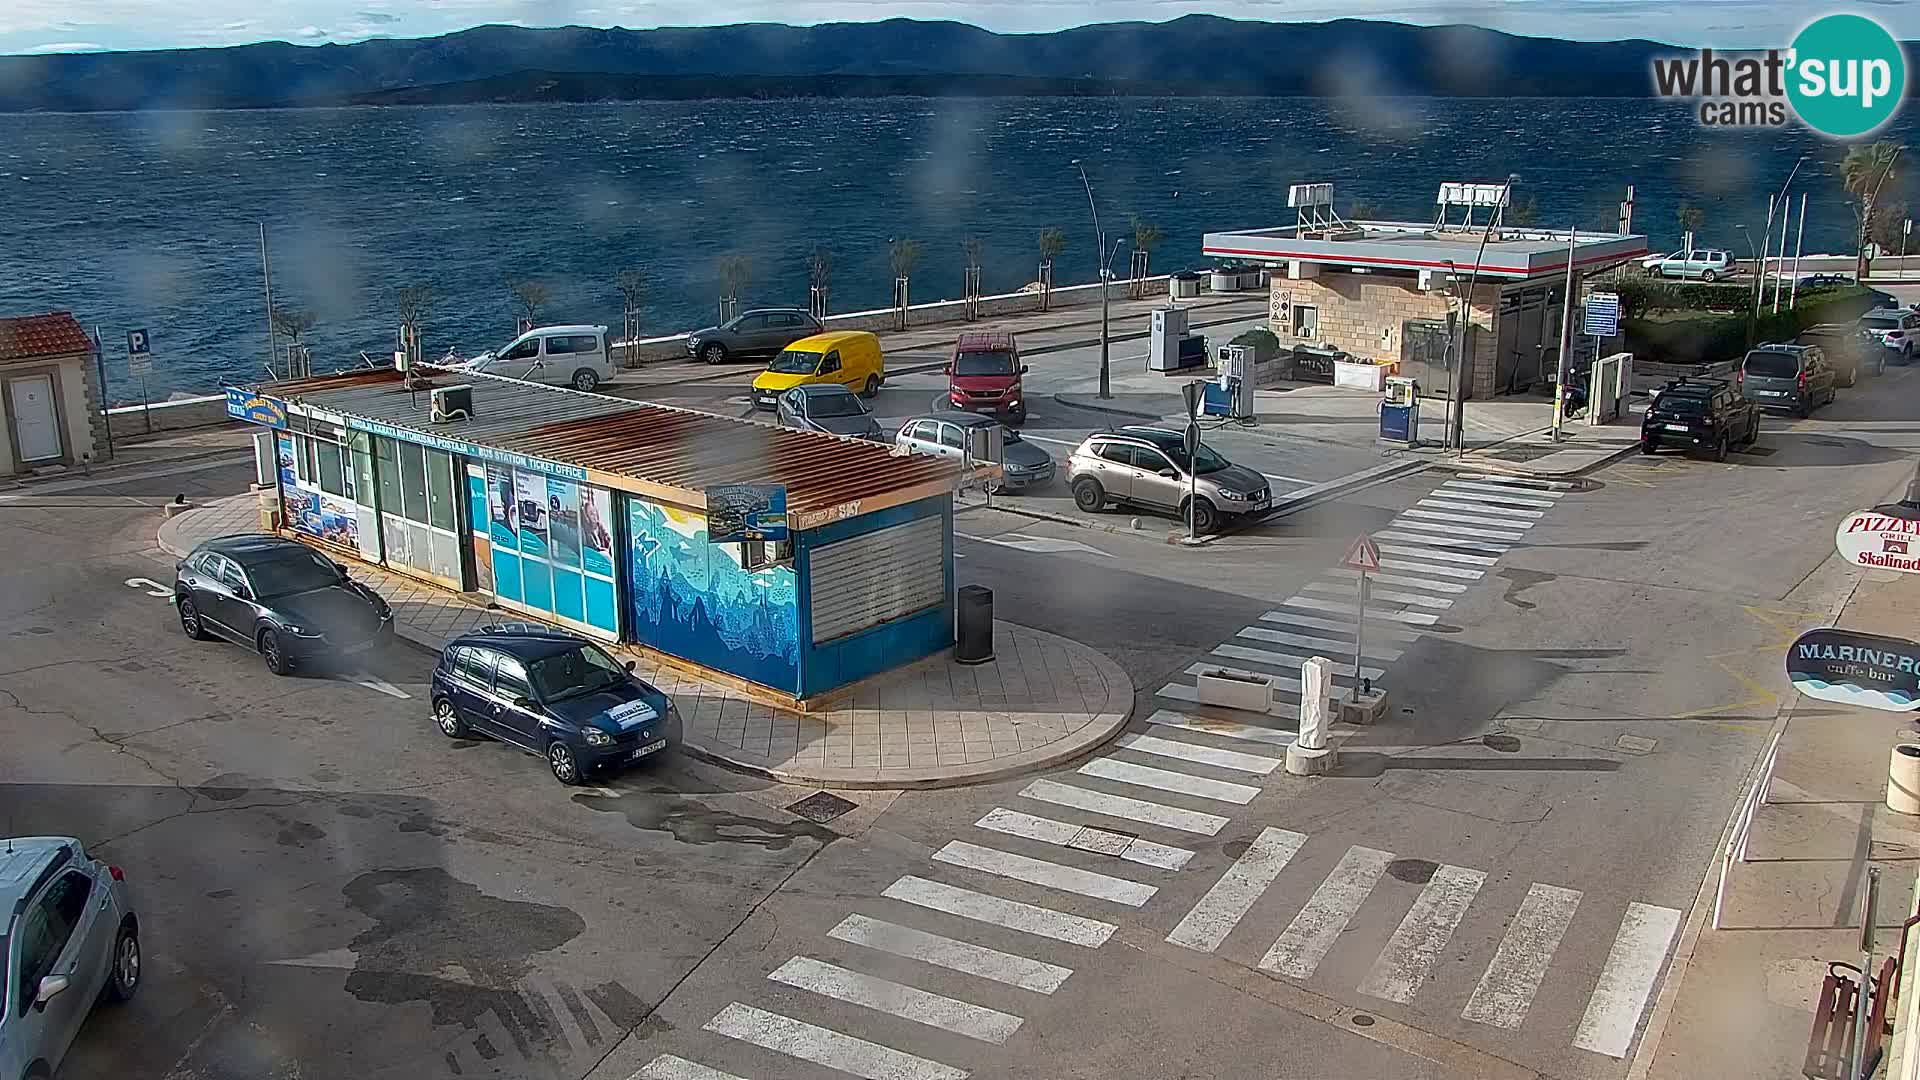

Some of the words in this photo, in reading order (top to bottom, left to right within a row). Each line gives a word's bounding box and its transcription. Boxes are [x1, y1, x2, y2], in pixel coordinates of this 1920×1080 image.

[131, 332, 144, 351] P
[396, 429, 437, 446] AUTOBUSNA
[437, 438, 468, 454] POSTAJA
[479, 447, 494, 458] BUS
[494, 450, 527, 467] STATION
[528, 459, 554, 473] TICKET
[555, 465, 583, 478] OFFICE
[838, 500, 862, 518] SKY
[1880, 532, 1915, 542] GRILL
[1827, 664, 1865, 677] caffe
[1869, 667, 1895, 682] bar
